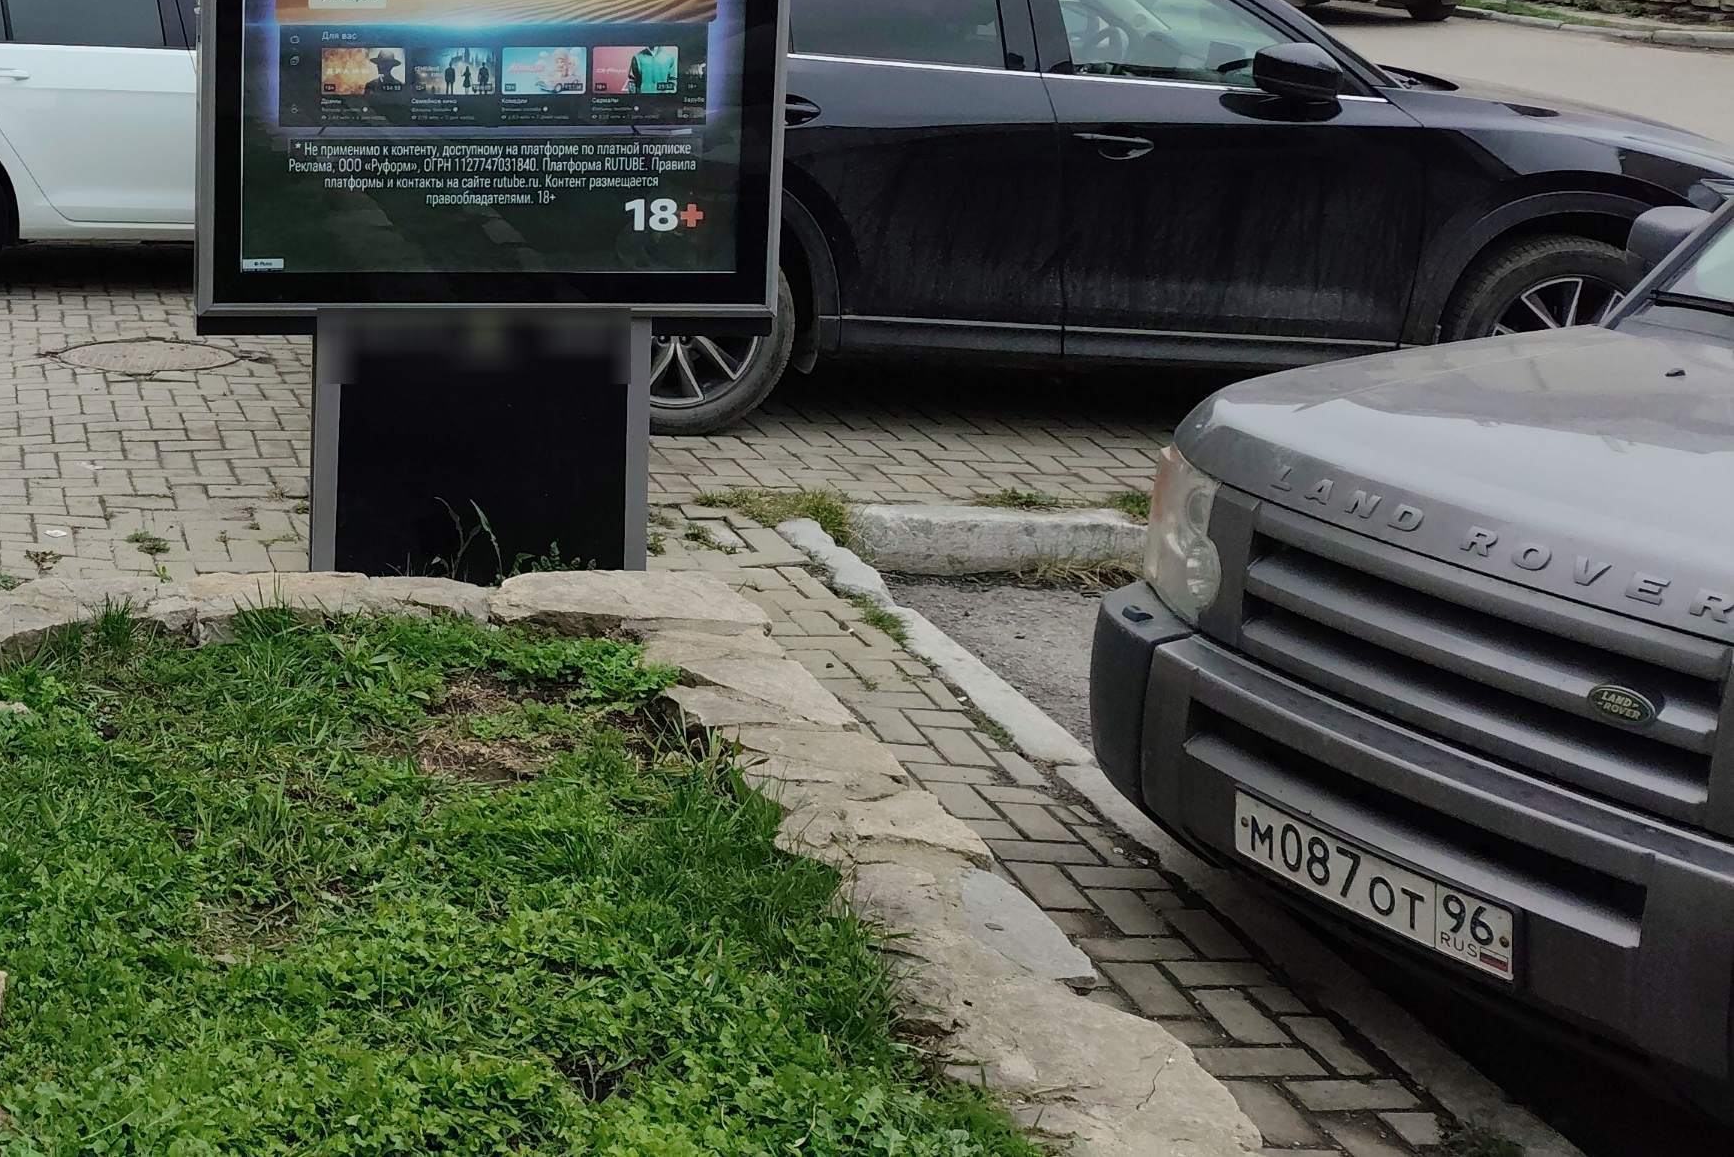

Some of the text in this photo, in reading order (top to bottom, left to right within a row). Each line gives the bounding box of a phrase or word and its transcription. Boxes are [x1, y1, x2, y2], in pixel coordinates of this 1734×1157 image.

[321, 31, 358, 42] Для вас
[304, 142, 692, 160] Не применимо к контенту, доступному на платформе по платной подписке
[288, 157, 697, 175] Реклама, ООО «Руформ», ОГРН 1127747031840. Платформа RUTUBE. Правила
[324, 174, 659, 191] платформы и контакты на сайте rutube.ru. Контент размещается
[425, 191, 557, 206] правообладателями. 18+
[625, 198, 704, 231] 18+
[1269, 465, 1734, 623] LAND ROVER
[1601, 691, 1633, 707] LAND
[1602, 702, 1641, 720] ROVER
[1250, 814, 1495, 946] М087ОТ 96
[1440, 931, 1479, 958] RUS
